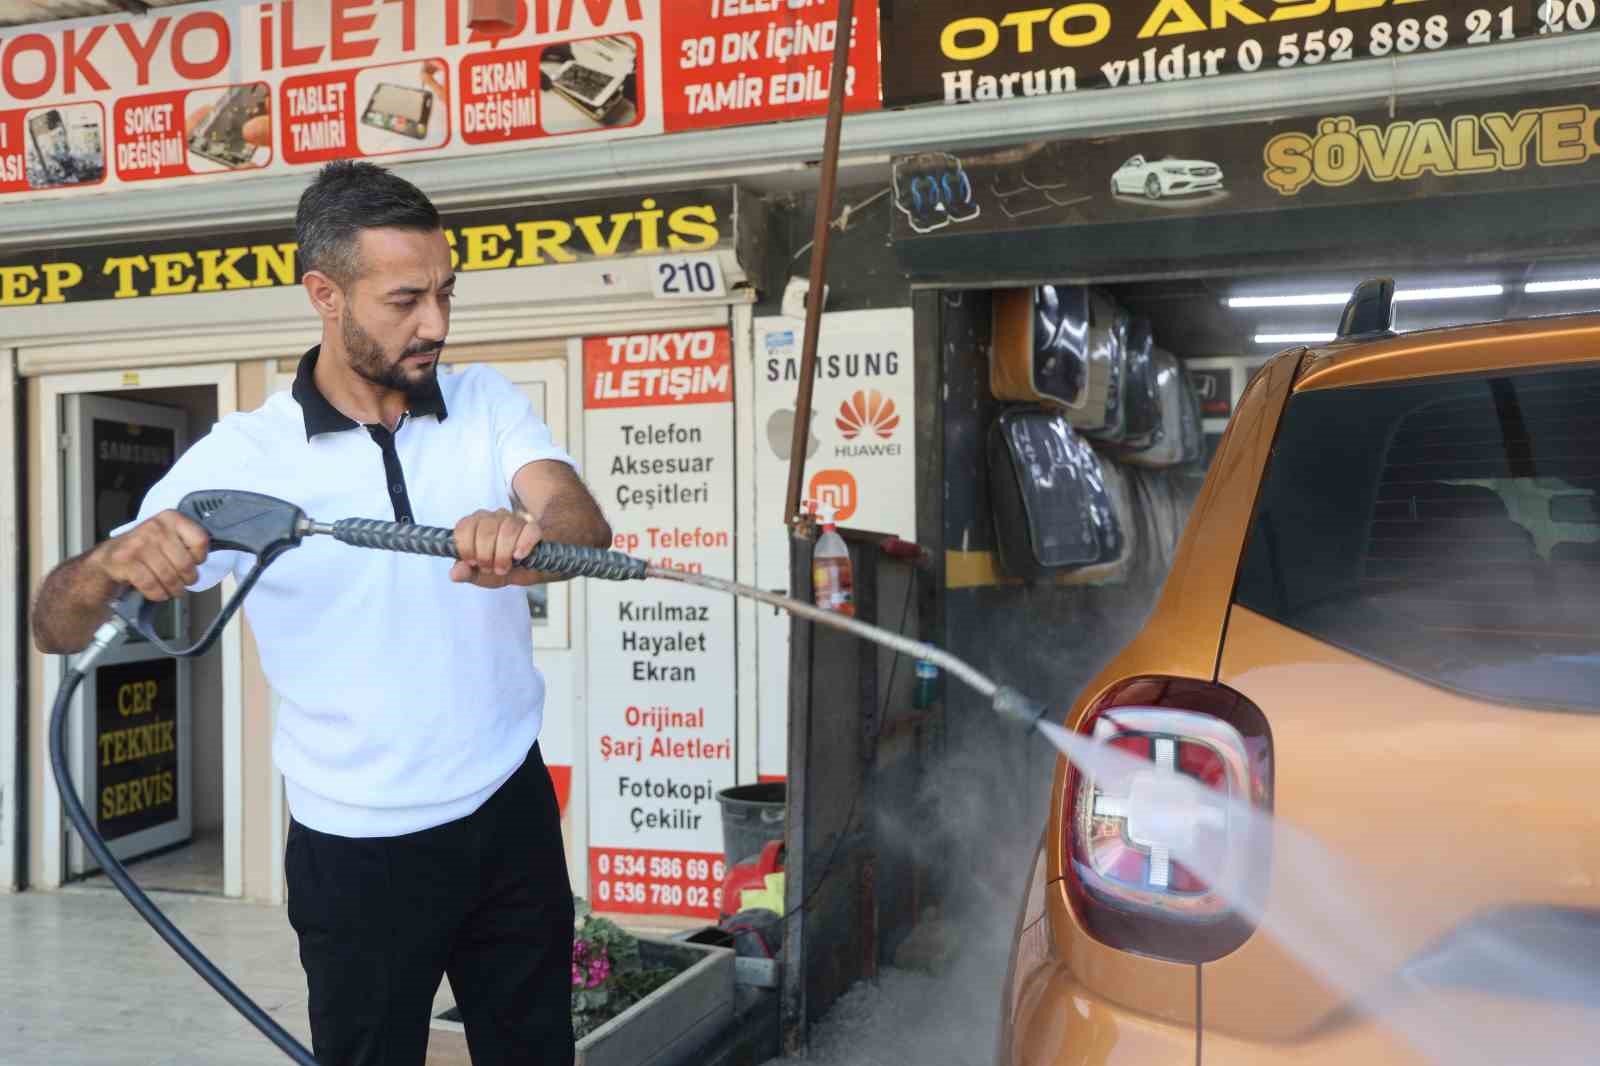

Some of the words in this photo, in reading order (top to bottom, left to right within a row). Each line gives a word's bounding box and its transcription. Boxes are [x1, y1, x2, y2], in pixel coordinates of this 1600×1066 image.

[680, 36, 716, 69] 30
[721, 30, 761, 64] DK
[765, 18, 858, 64] İÇİND
[940, 3, 1111, 61] OTO
[0, 11, 231, 100] OKYO
[941, 64, 1077, 104] Harun
[1237, 39, 1263, 71] 0
[1277, 27, 1354, 67] 552
[1369, 14, 1448, 56] 888
[1465, 8, 1515, 44] 21
[1537, 0, 1595, 34] 20
[471, 60, 527, 96] EKRAN
[684, 72, 764, 114] TAMİR
[287, 83, 348, 116] TABLET
[464, 90, 536, 136] DEĞİŞİMİ
[124, 104, 174, 135] SOKET
[291, 117, 346, 153] TAMİRİ
[117, 132, 184, 174] DEĞİŞİMİ
[1263, 104, 1600, 196] ŞÖVALYE
[0, 262, 83, 306] EP
[103, 242, 298, 298] TEKN
[659, 261, 715, 293] 210
[606, 331, 715, 365] TOKYO
[594, 364, 729, 400] İLETİŞİM
[621, 424, 701, 446] Telefon
[834, 443, 902, 458] HUAWEI
[611, 456, 714, 476] Aksesuar
[616, 483, 708, 510] Çeşitleri
[613, 532, 639, 553] ep
[646, 527, 728, 548] Telefon
[618, 601, 709, 622] Kırılmaz
[622, 631, 706, 656] Hayalet
[632, 661, 696, 682] Ekran
[117, 680, 158, 717] CEP
[625, 706, 704, 732] Orijinal
[98, 715, 175, 766] TEKNİK
[600, 736, 643, 762] Şarj
[650, 737, 731, 760] Aletleri
[101, 768, 174, 820] SERVİS
[618, 776, 713, 804] Fotokopi
[630, 807, 702, 832] Çekilir
[598, 854, 610, 875] 0
[614, 855, 646, 877] 534
[650, 857, 682, 879] 586
[712, 860, 725, 882] 6
[598, 880, 610, 901] 0
[614, 881, 646, 903] 536
[650, 884, 682, 906] 780
[687, 886, 709, 908] 02
